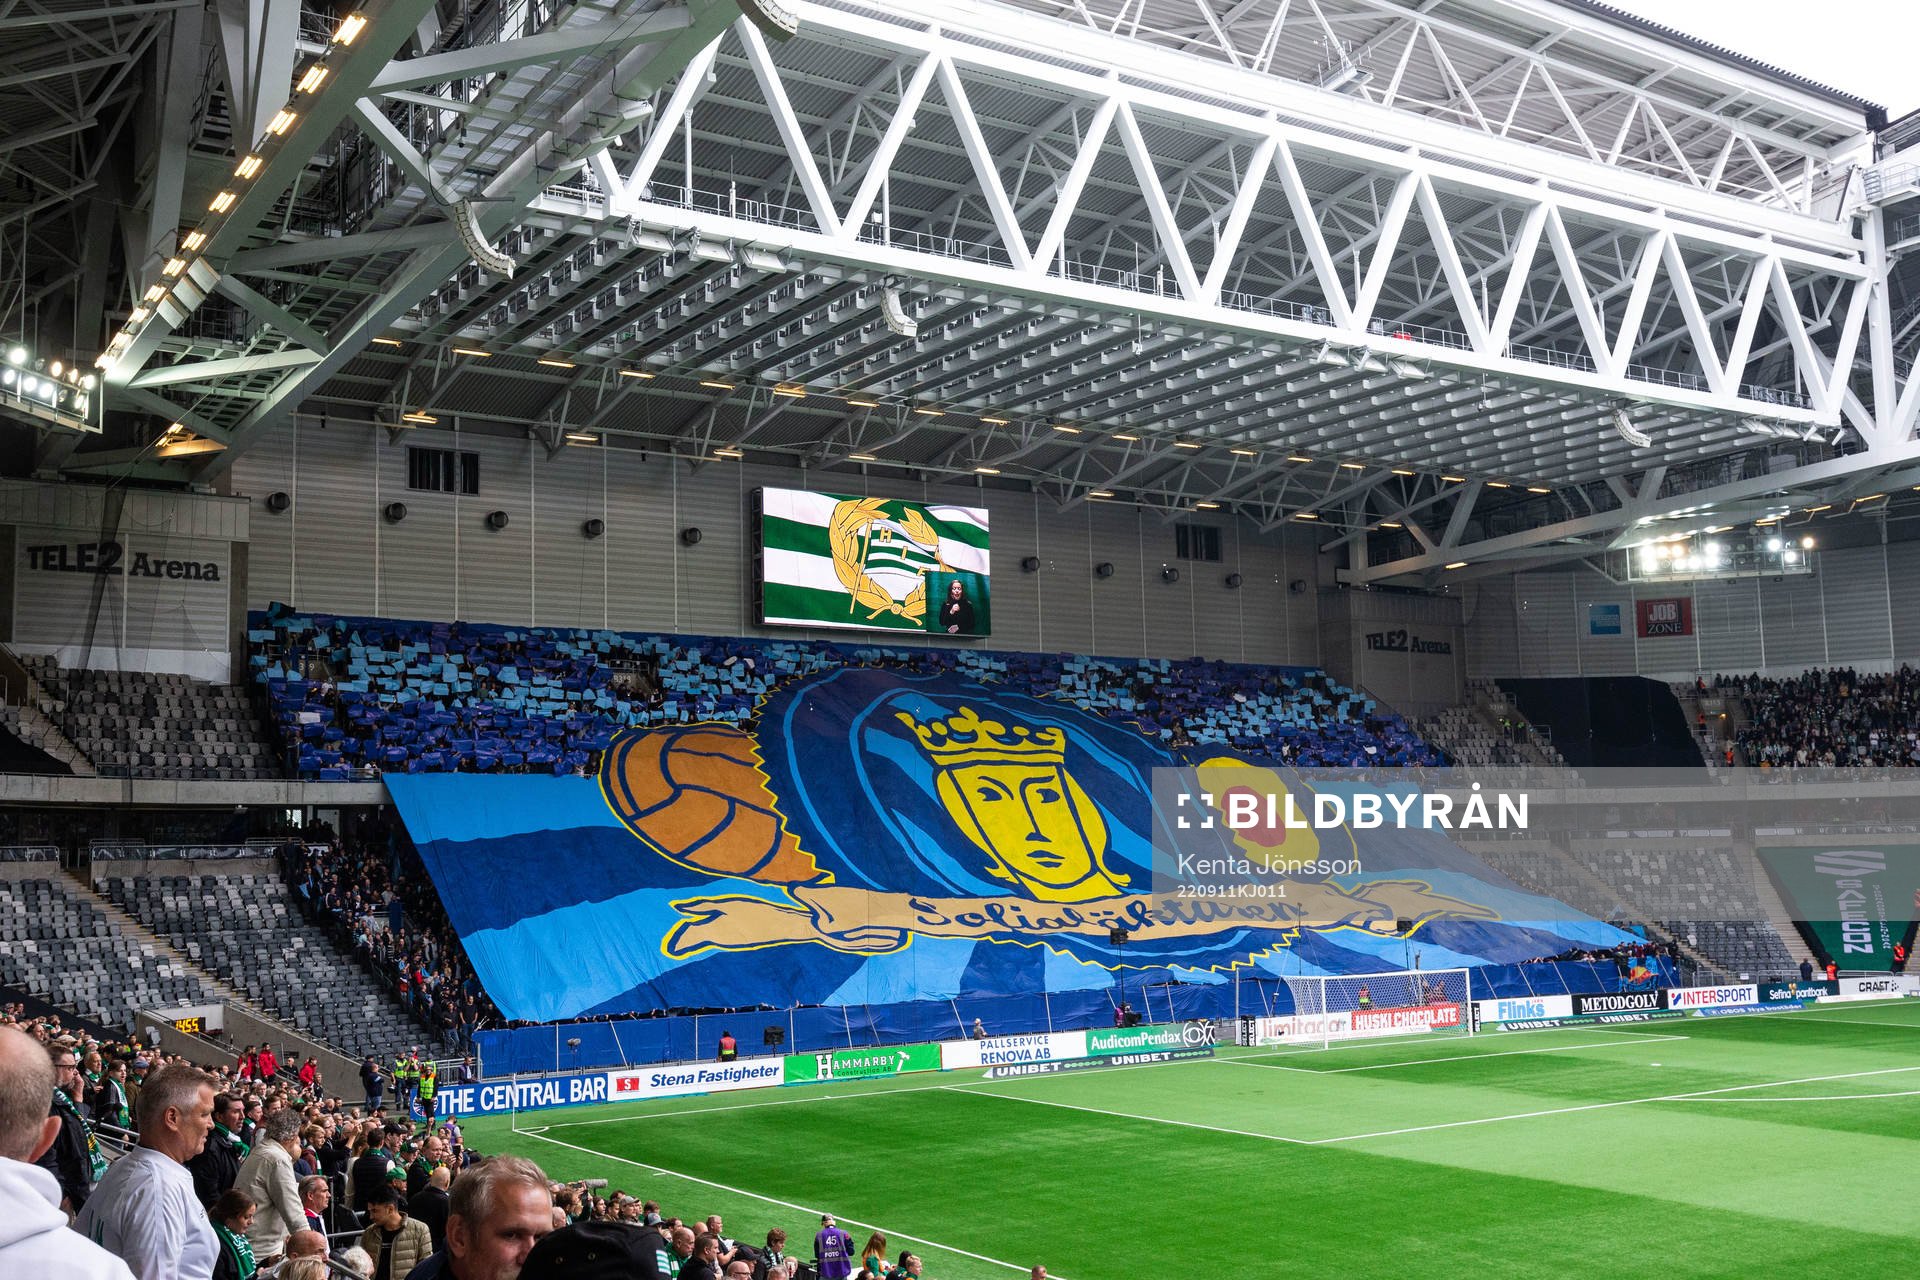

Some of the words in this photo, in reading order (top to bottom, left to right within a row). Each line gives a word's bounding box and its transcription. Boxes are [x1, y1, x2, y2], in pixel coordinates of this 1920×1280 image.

[27, 542, 123, 575] TELE2
[128, 551, 220, 582] Arena
[1649, 603, 1677, 621] JOB
[1648, 623, 1682, 634] ZONE
[1365, 629, 1408, 652] TELE2
[1410, 636, 1451, 655] Arena
[1769, 989, 1791, 1000] Sefina
[1795, 986, 1828, 999] pantbank
[1859, 981, 1890, 993] CRAFT
[1581, 993, 1659, 1012] METODGOLV
[1683, 987, 1752, 1005] INTERSPORT
[1498, 1000, 1546, 1019] Flinks
[1356, 1012, 1392, 1031] HUSKI
[1393, 1007, 1457, 1027] CHOCOLATE
[1508, 1019, 1561, 1031] UNIBET
[1600, 1013, 1650, 1024] UNIBET
[980, 1036, 1049, 1050] PALLSERVICE
[1091, 1030, 1181, 1050] AudicomPendax
[981, 1048, 1032, 1064] RENOVA
[1034, 1047, 1051, 1060] AB
[1111, 1051, 1171, 1065] UNIBET
[816, 1053, 895, 1080] HAMMARBY
[996, 1062, 1062, 1076] UNIBET
[624, 1079, 632, 1090] S
[650, 1073, 695, 1088] Stena
[699, 1065, 780, 1083] Fastigheter
[438, 1088, 475, 1115] THE
[480, 1080, 566, 1111] CENTRAL
[570, 1076, 606, 1103] BAR
[825, 1235, 837, 1246] 45
[824, 1250, 840, 1258] FOTO
